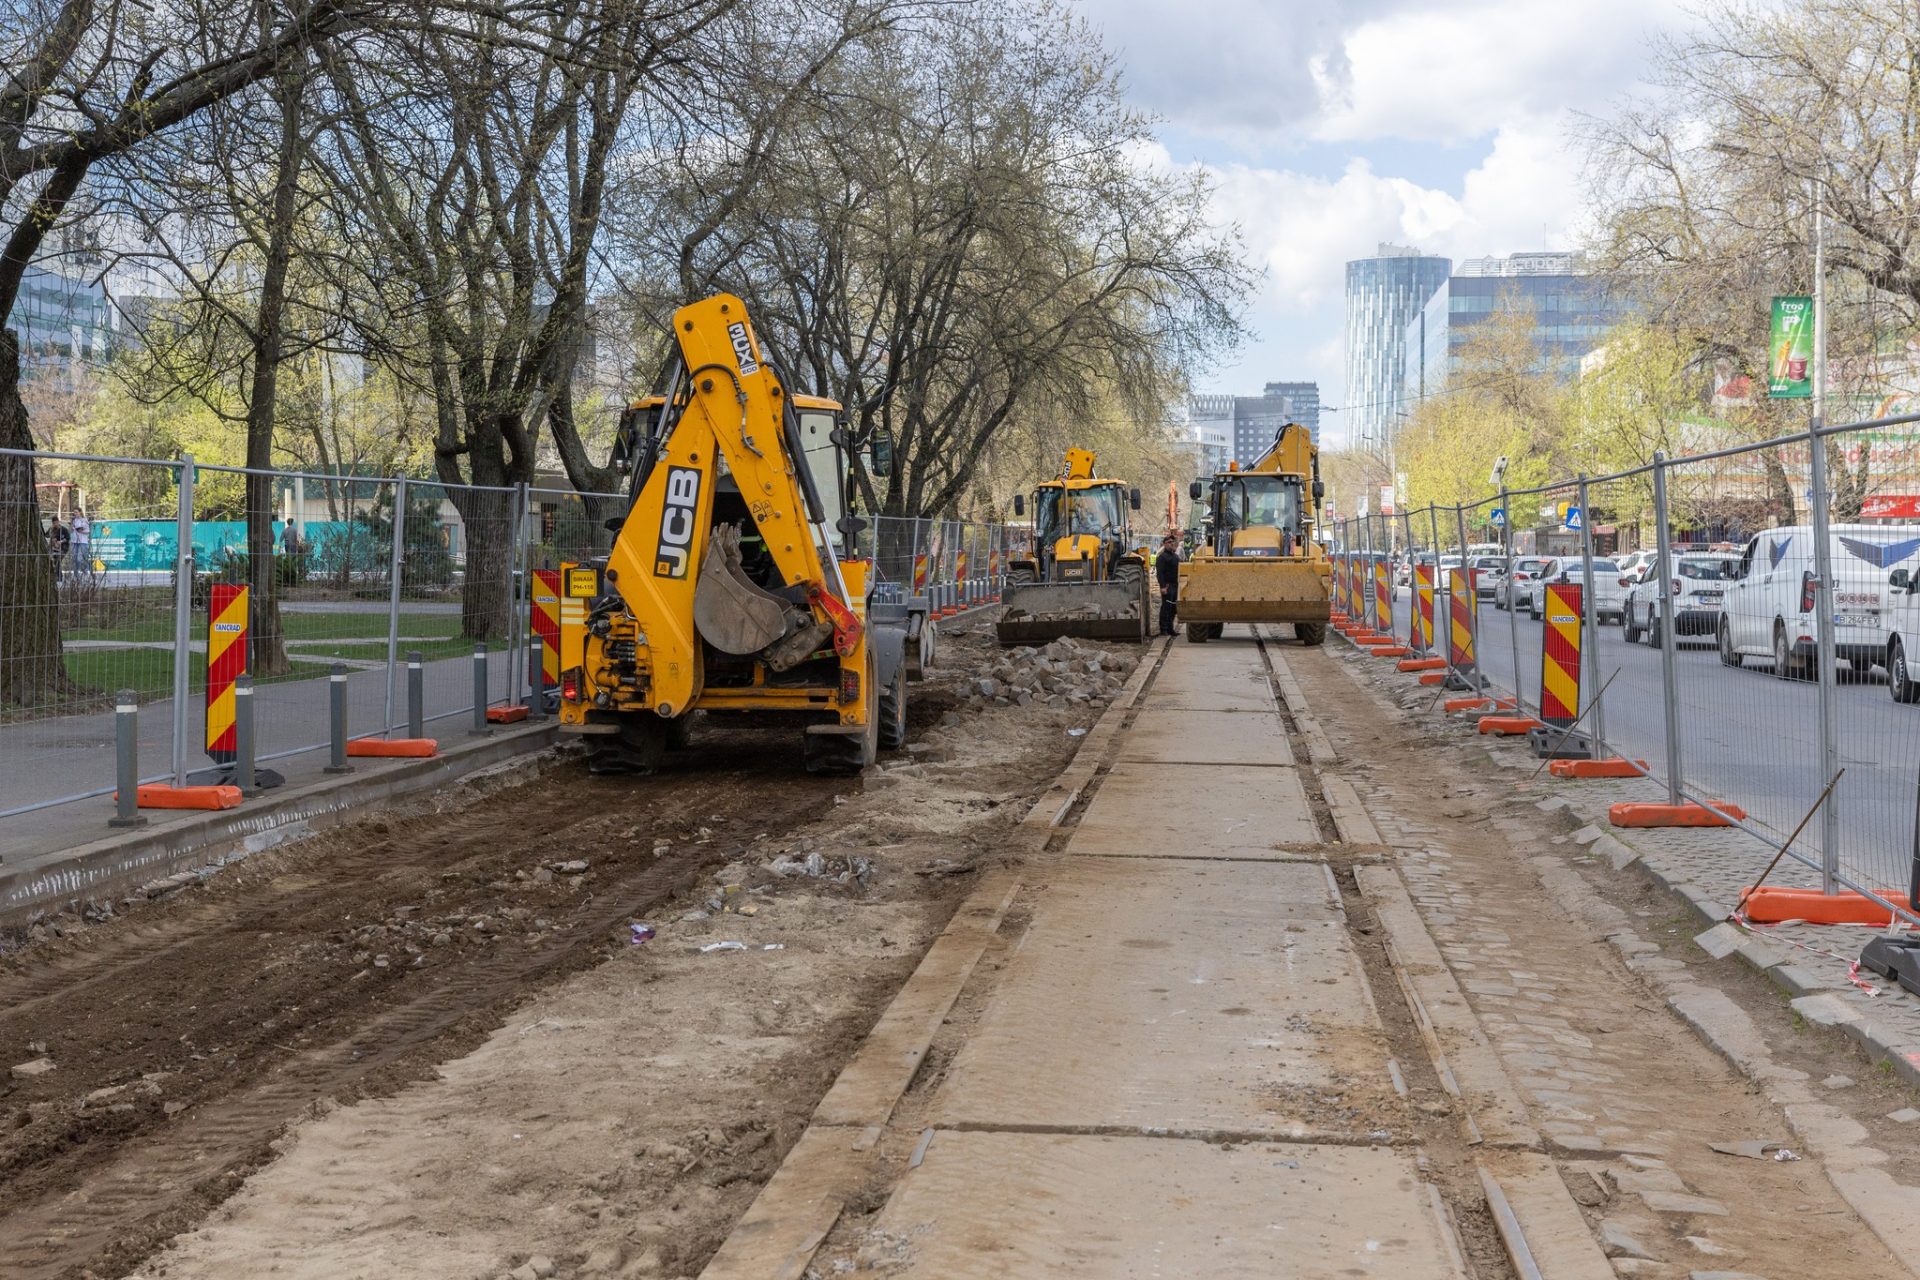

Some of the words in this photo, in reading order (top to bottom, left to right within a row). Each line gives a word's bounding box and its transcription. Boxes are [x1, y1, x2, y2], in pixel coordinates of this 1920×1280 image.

[728, 322, 755, 366] 3CX
[742, 366, 758, 375] ECO
[660, 469, 699, 577] JCB
